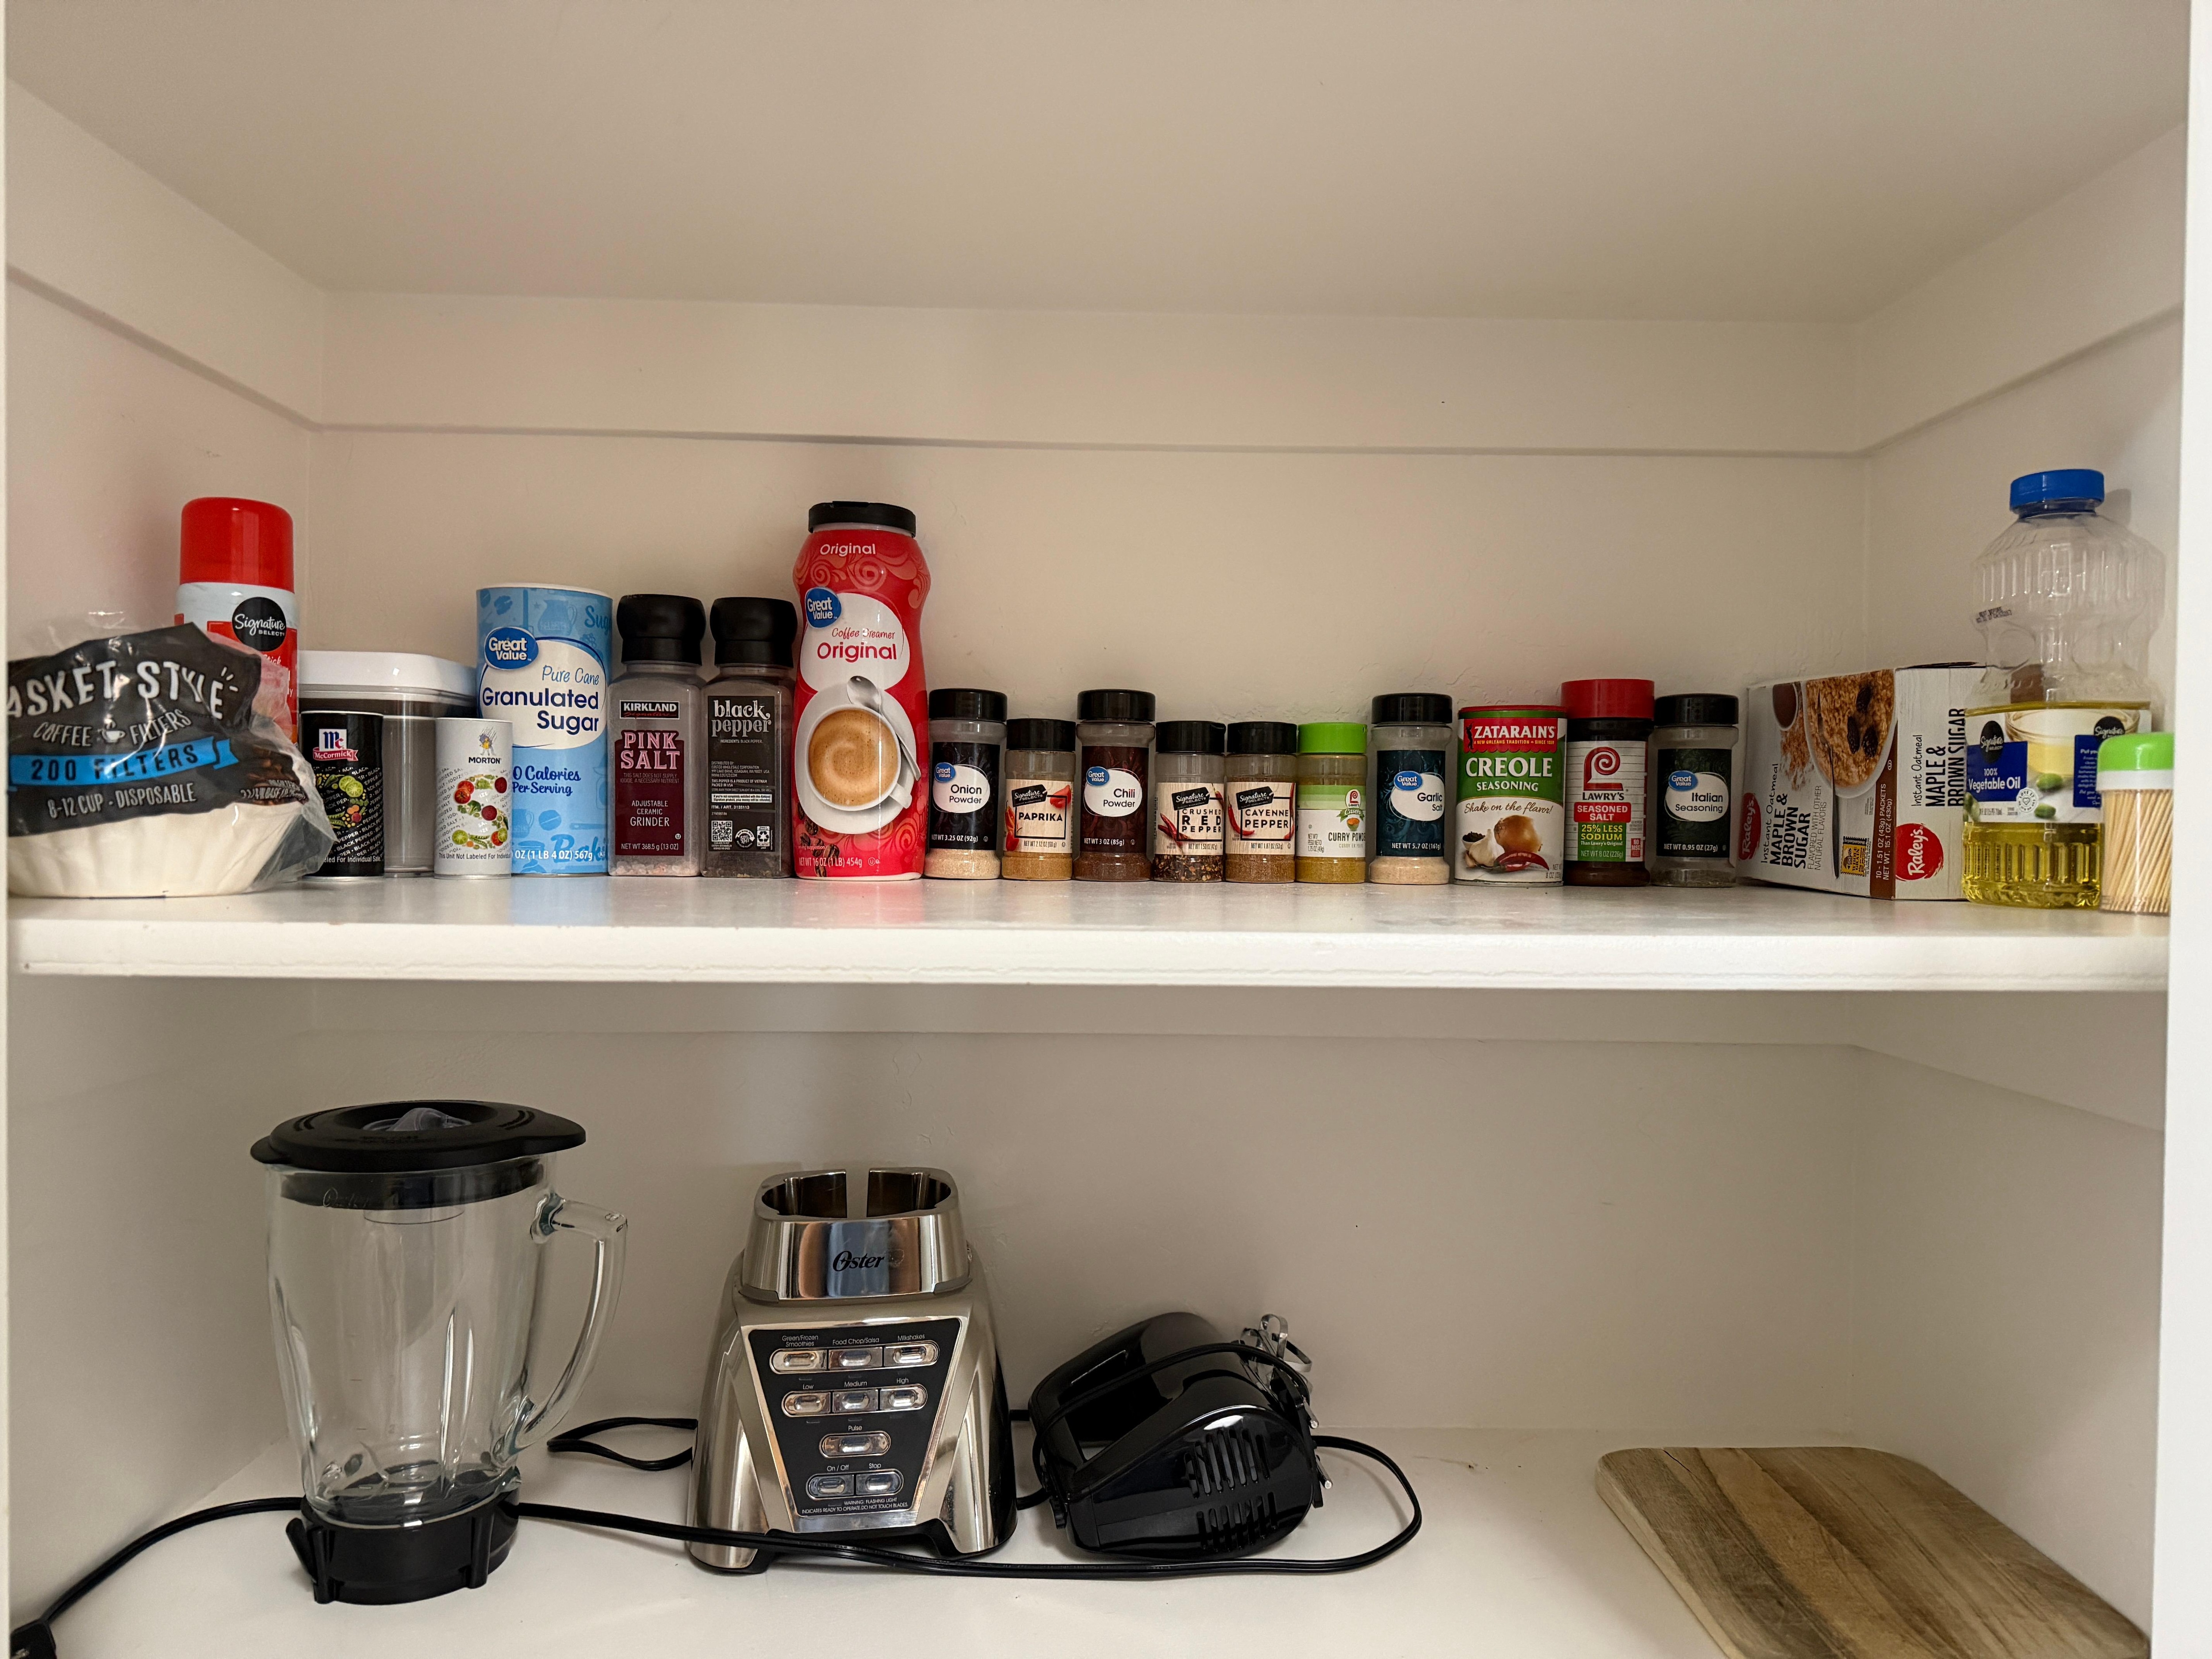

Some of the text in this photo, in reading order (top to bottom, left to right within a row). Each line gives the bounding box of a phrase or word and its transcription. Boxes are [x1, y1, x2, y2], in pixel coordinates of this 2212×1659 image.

[820, 543, 876, 557] Original
[807, 597, 832, 612] Great
[813, 610, 833, 619] Value
[234, 613, 285, 636] Signature
[832, 628, 895, 639] Coffee Creamer
[488, 637, 527, 652] Great
[496, 650, 527, 661] Value
[817, 642, 897, 663] Original
[542, 664, 599, 685] Pure Cane
[137, 661, 223, 719] STYLE
[483, 687, 599, 710] Granulated
[624, 703, 677, 712] KIRKLAND
[713, 700, 771, 720] black
[34, 709, 192, 747] COFFEE FILTERS
[537, 710, 599, 735] Sugar
[711, 719, 772, 737] pepper
[1474, 726, 1555, 739] ZATARAIN'S
[624, 732, 677, 749] PINK
[314, 750, 352, 759] McCormick
[621, 750, 680, 769] SALT
[1948, 709, 1965, 807] BROWN SUGAR
[31, 744, 199, 781] 200 FILTERS
[1466, 757, 1552, 777] CREOLE
[525, 765, 581, 781] Calories
[1911, 734, 1923, 807] Instant Oatmeal
[1925, 746, 1946, 807] MAPLE &
[512, 782, 573, 797] Per Serving
[951, 784, 982, 794] Onion
[1476, 780, 1539, 791] SEASONING
[1969, 776, 2021, 793] Vegetable Oil
[79, 783, 197, 814] CUP DISPOSABLE
[1014, 791, 1041, 801] Signature
[1114, 789, 1135, 798] Chili
[1175, 793, 1204, 804] Signature
[1240, 792, 1267, 803] Signature
[1417, 792, 1443, 802] Garlic
[1582, 792, 1624, 801] LAWRY'S
[1692, 792, 1723, 803] Italian
[1464, 802, 1490, 814] Shake
[1505, 801, 1522, 811] the
[1522, 802, 1553, 814] flavor!
[1675, 804, 1723, 813] Seasoning
[1761, 764, 1778, 864] Instant Oatmeal
[630, 817, 669, 826] GRINDER
[1018, 812, 1063, 821] PAPRIKA
[1182, 815, 1221, 826] RED
[1245, 819, 1289, 828] PEPPER
[1742, 799, 1756, 855] Raley's
[1770, 793, 1788, 865] MAPLE &
[1807, 832, 1817, 869] FLAVORED
[1813, 785, 1822, 809] OTHER
[1886, 822, 1891, 831] OZ
[1328, 832, 1350, 841] CURRY
[1782, 807, 1799, 867] BROWN
[1794, 813, 1811, 869] SUGAR
[1815, 801, 1827, 870] NATURAL FLAVORS
[1878, 838, 1884, 848] OZ
[515, 850, 593, 861] OZ LB 4 OZ) 567g
[1908, 828, 1929, 876] Raley's
[819, 857, 862, 868] OZ 454g
[833, 1250, 885, 1272] Oster
[848, 1337, 879, 1345] Chop/Salsa
